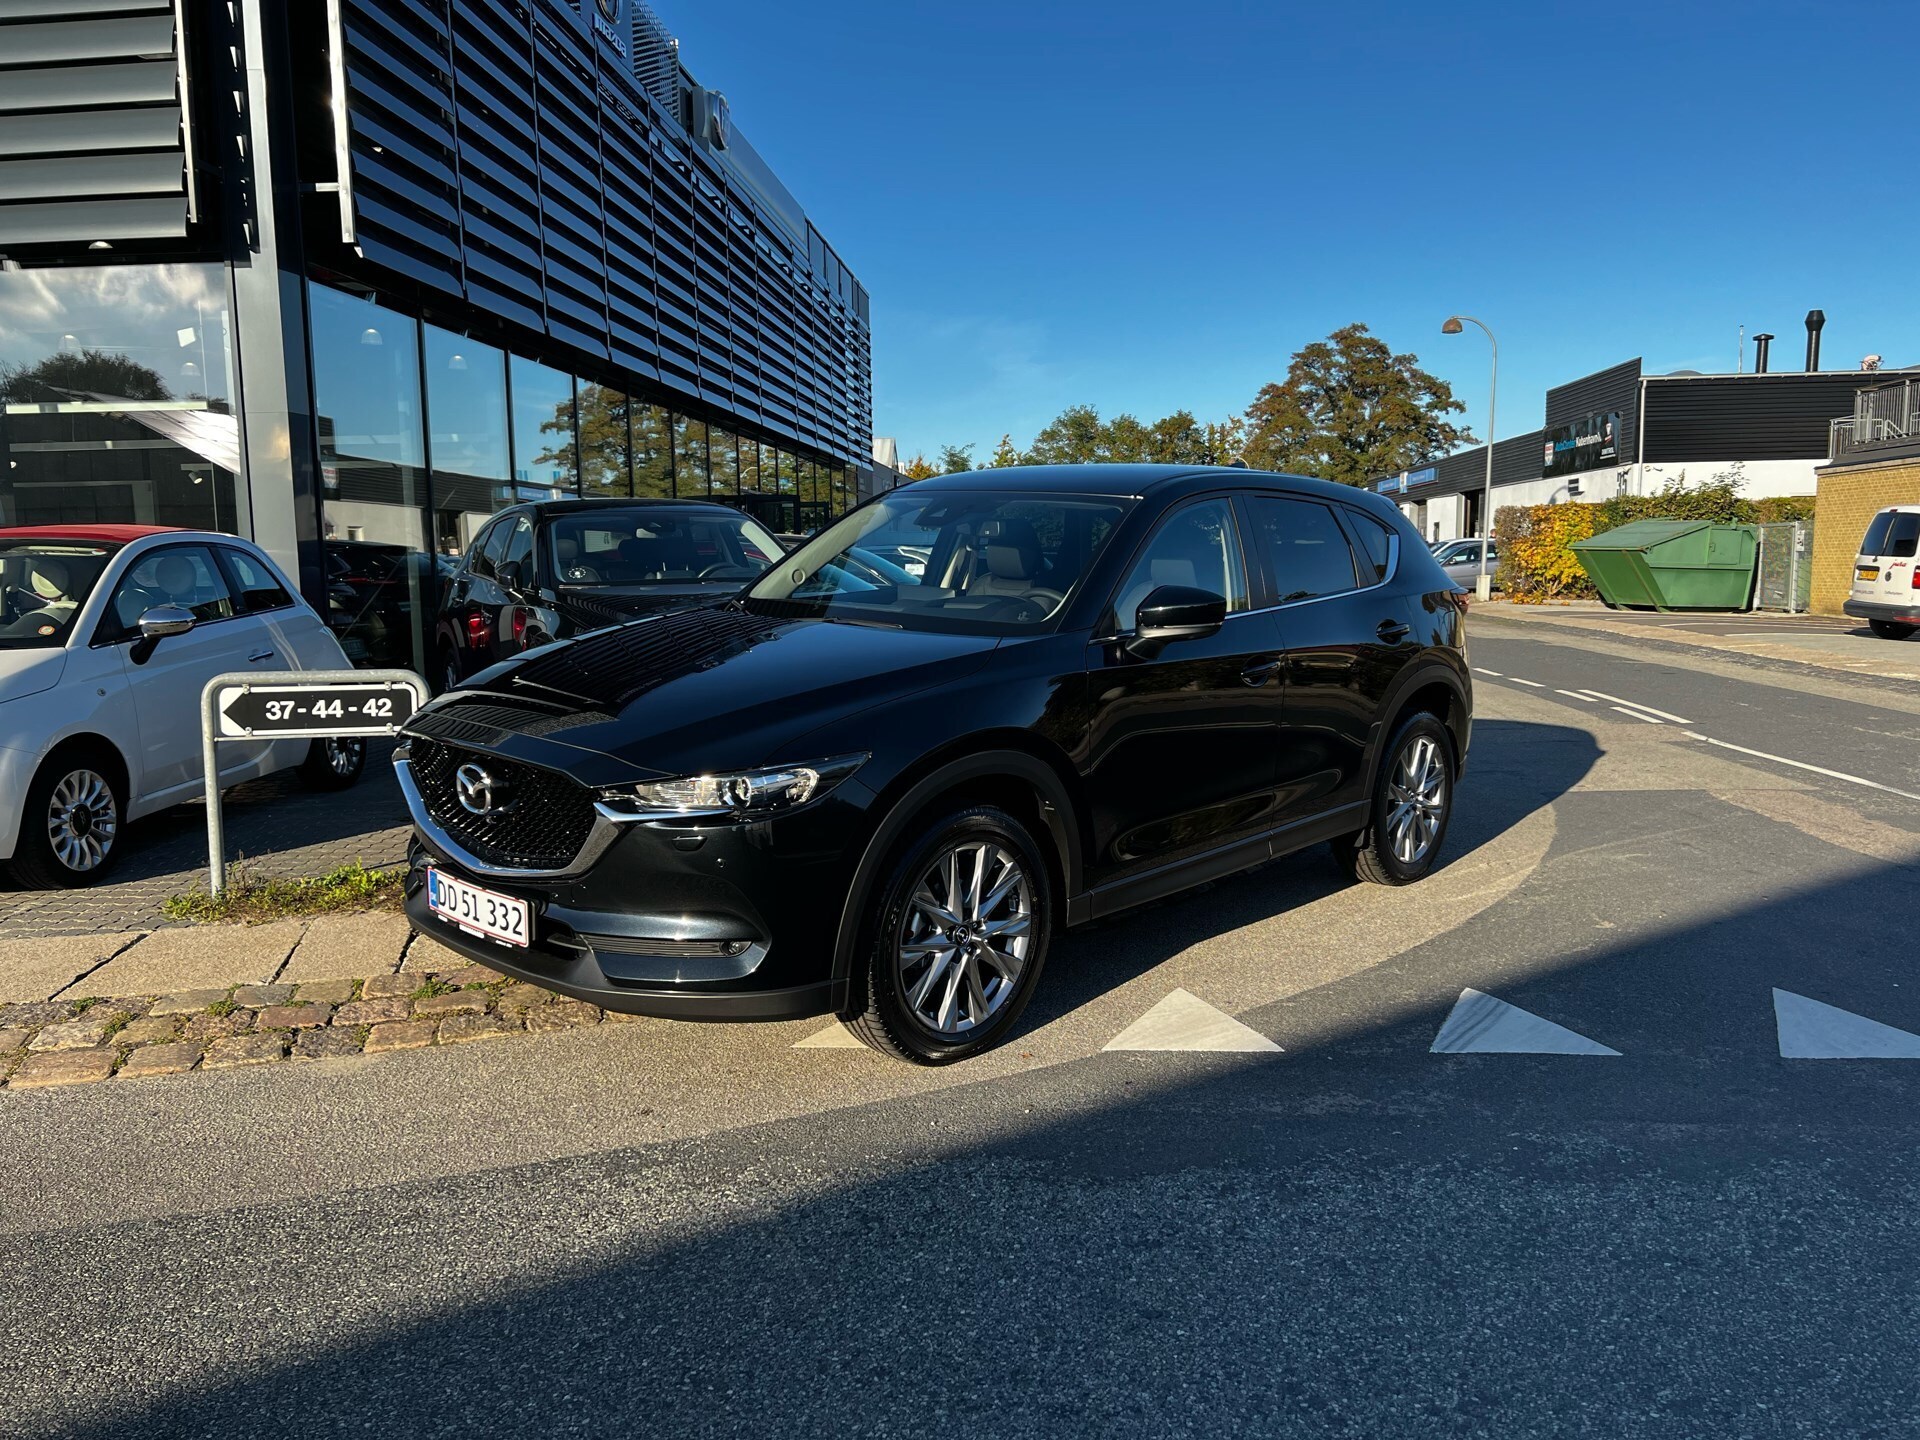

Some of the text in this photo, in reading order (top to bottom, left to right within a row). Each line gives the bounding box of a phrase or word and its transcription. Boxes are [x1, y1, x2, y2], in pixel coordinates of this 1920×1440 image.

[593, 12, 627, 58] mazda
[438, 880, 457, 912] DD
[462, 889, 480, 923] 51
[487, 898, 523, 937] 332
